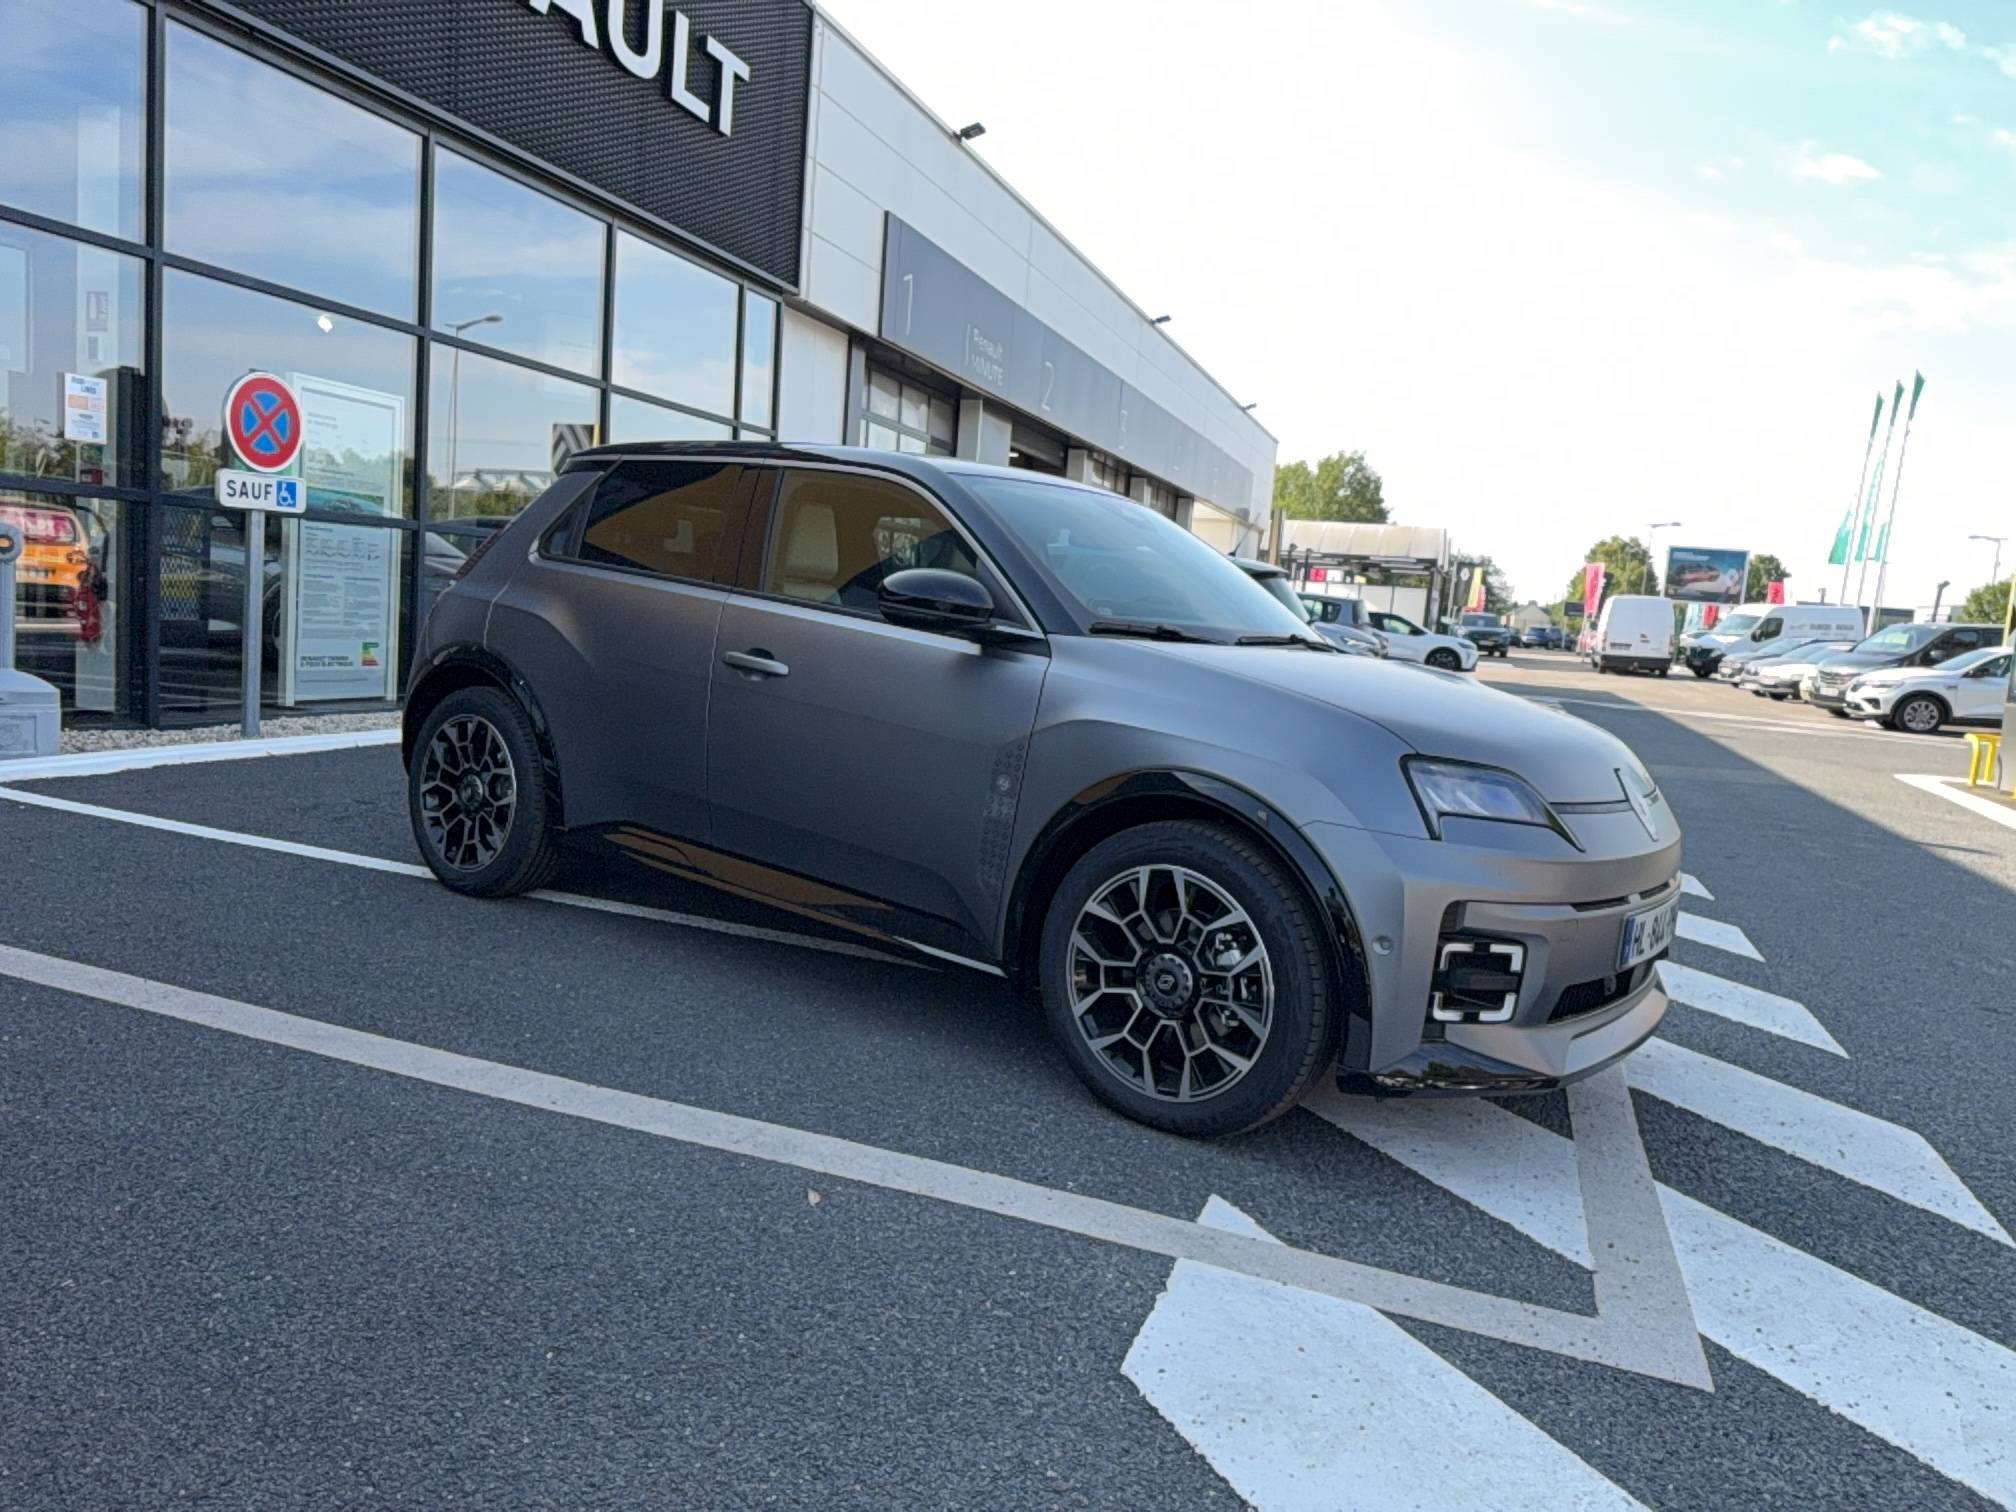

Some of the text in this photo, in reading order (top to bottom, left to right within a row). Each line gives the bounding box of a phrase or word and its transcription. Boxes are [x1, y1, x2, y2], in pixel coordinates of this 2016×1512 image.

[903, 274, 912, 336] 1
[1041, 361, 1055, 411] 2
[226, 479, 273, 500] SAUF
